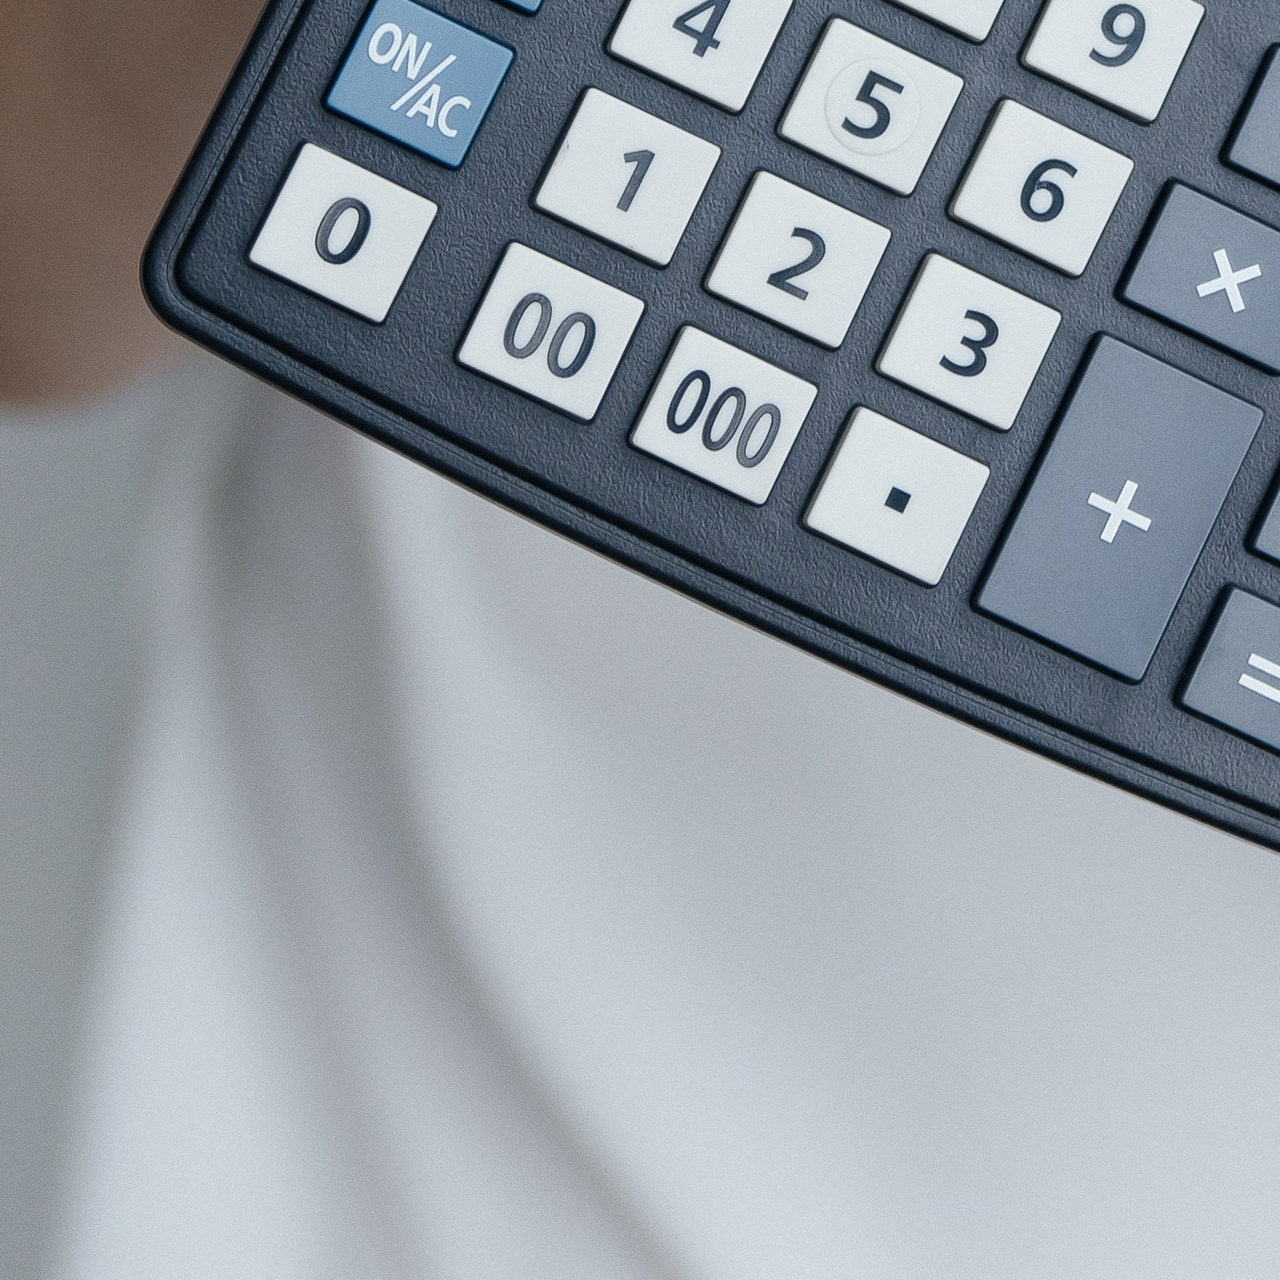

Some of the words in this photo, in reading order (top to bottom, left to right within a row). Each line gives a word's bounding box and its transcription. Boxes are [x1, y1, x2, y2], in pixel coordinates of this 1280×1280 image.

[1089, 3, 1146, 67] 9
[842, 70, 904, 139] 5
[617, 149, 655, 212] 1
[1020, 159, 1077, 222] 6
[315, 197, 371, 265] 0
[767, 227, 826, 301] 2
[503, 292, 596, 378] 00
[939, 310, 999, 377] 3
[666, 370, 780, 468] 000
